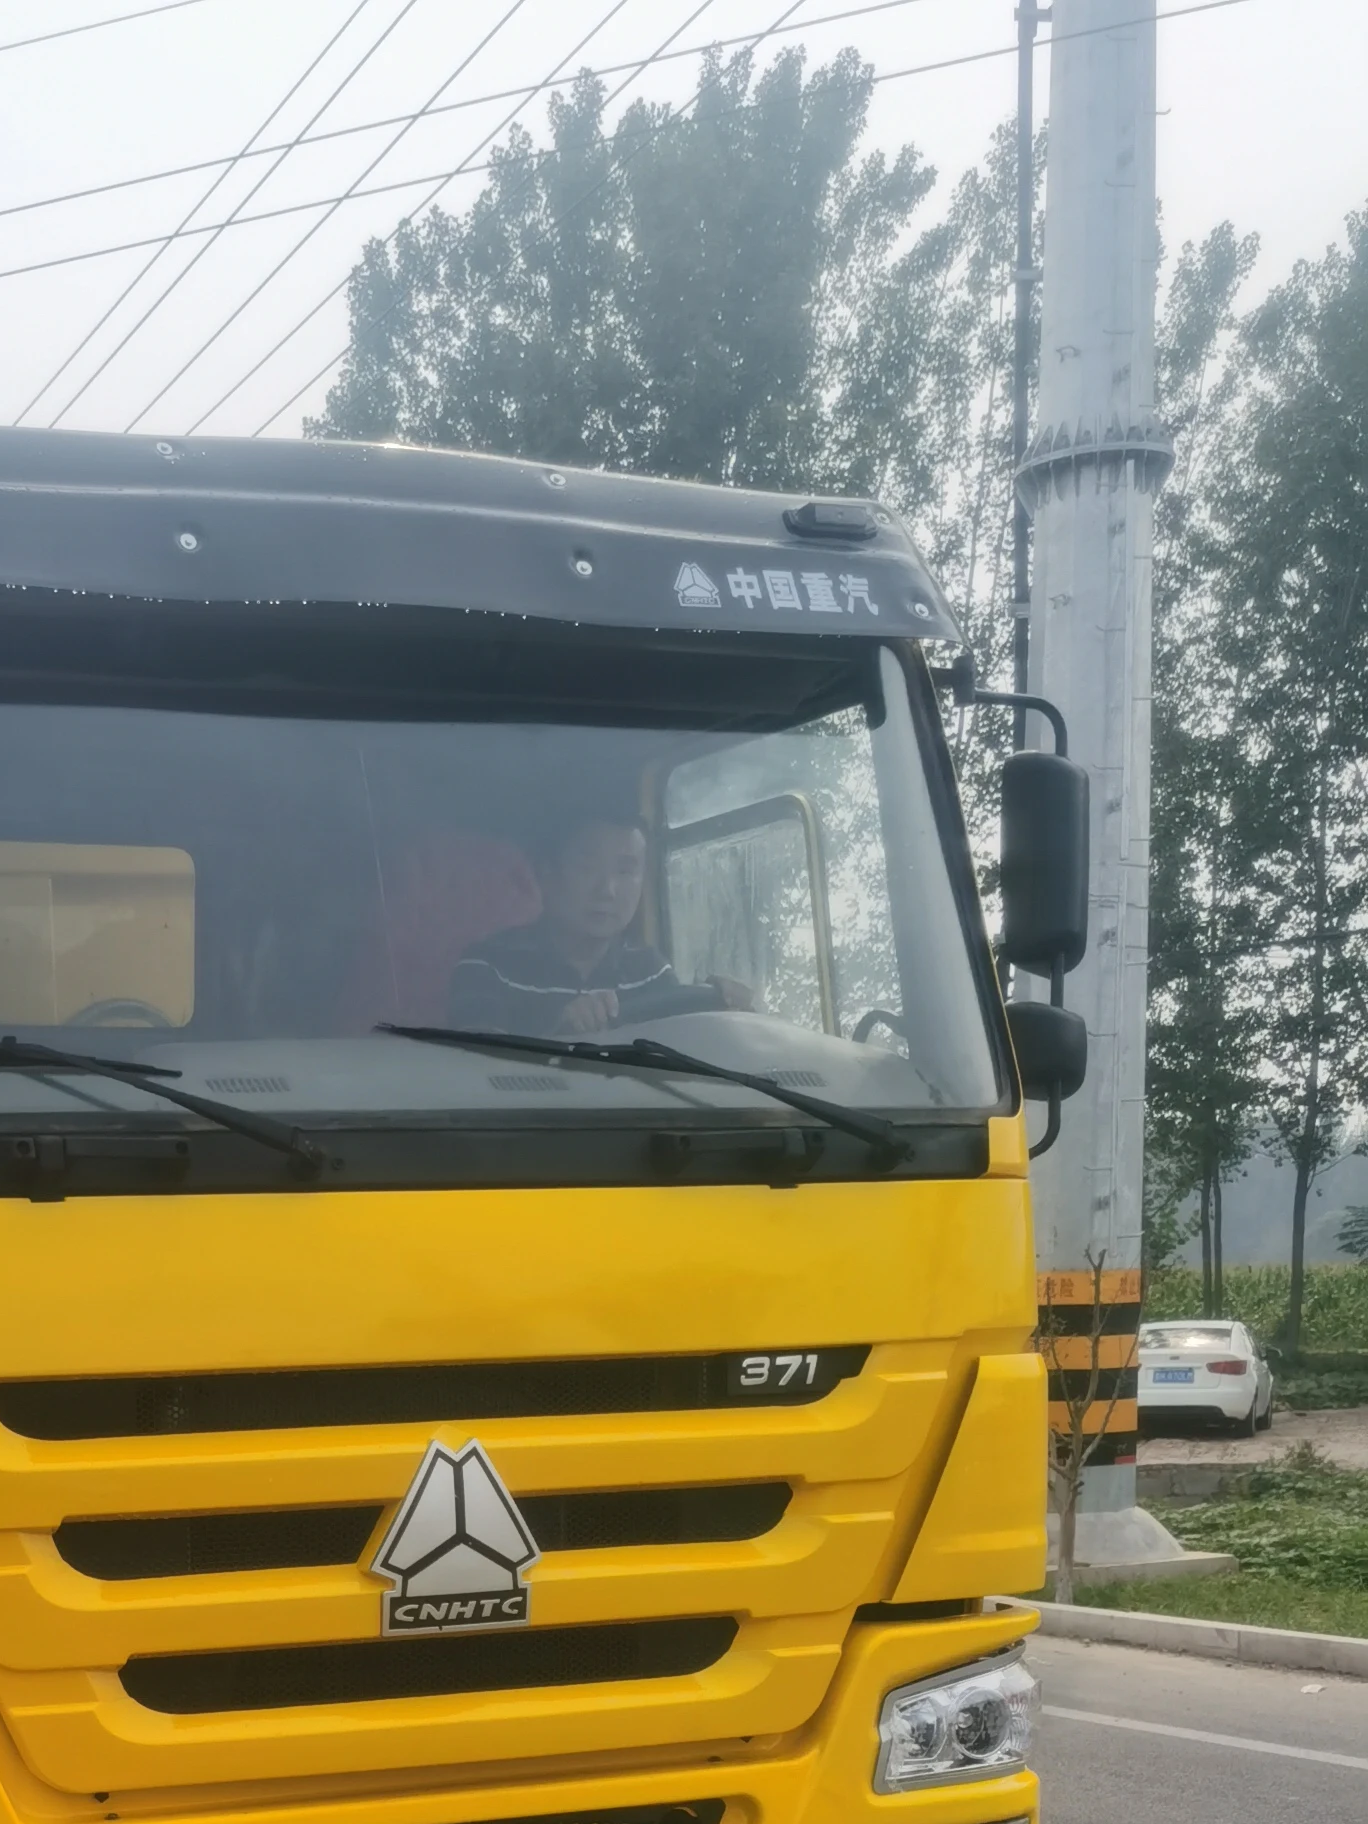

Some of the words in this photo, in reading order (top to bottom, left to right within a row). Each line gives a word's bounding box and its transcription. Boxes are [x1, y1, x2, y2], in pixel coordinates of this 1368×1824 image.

[726, 567, 879, 616] 中国重汽
[740, 1354, 818, 1386] 371
[394, 1596, 523, 1623] CNHTC
